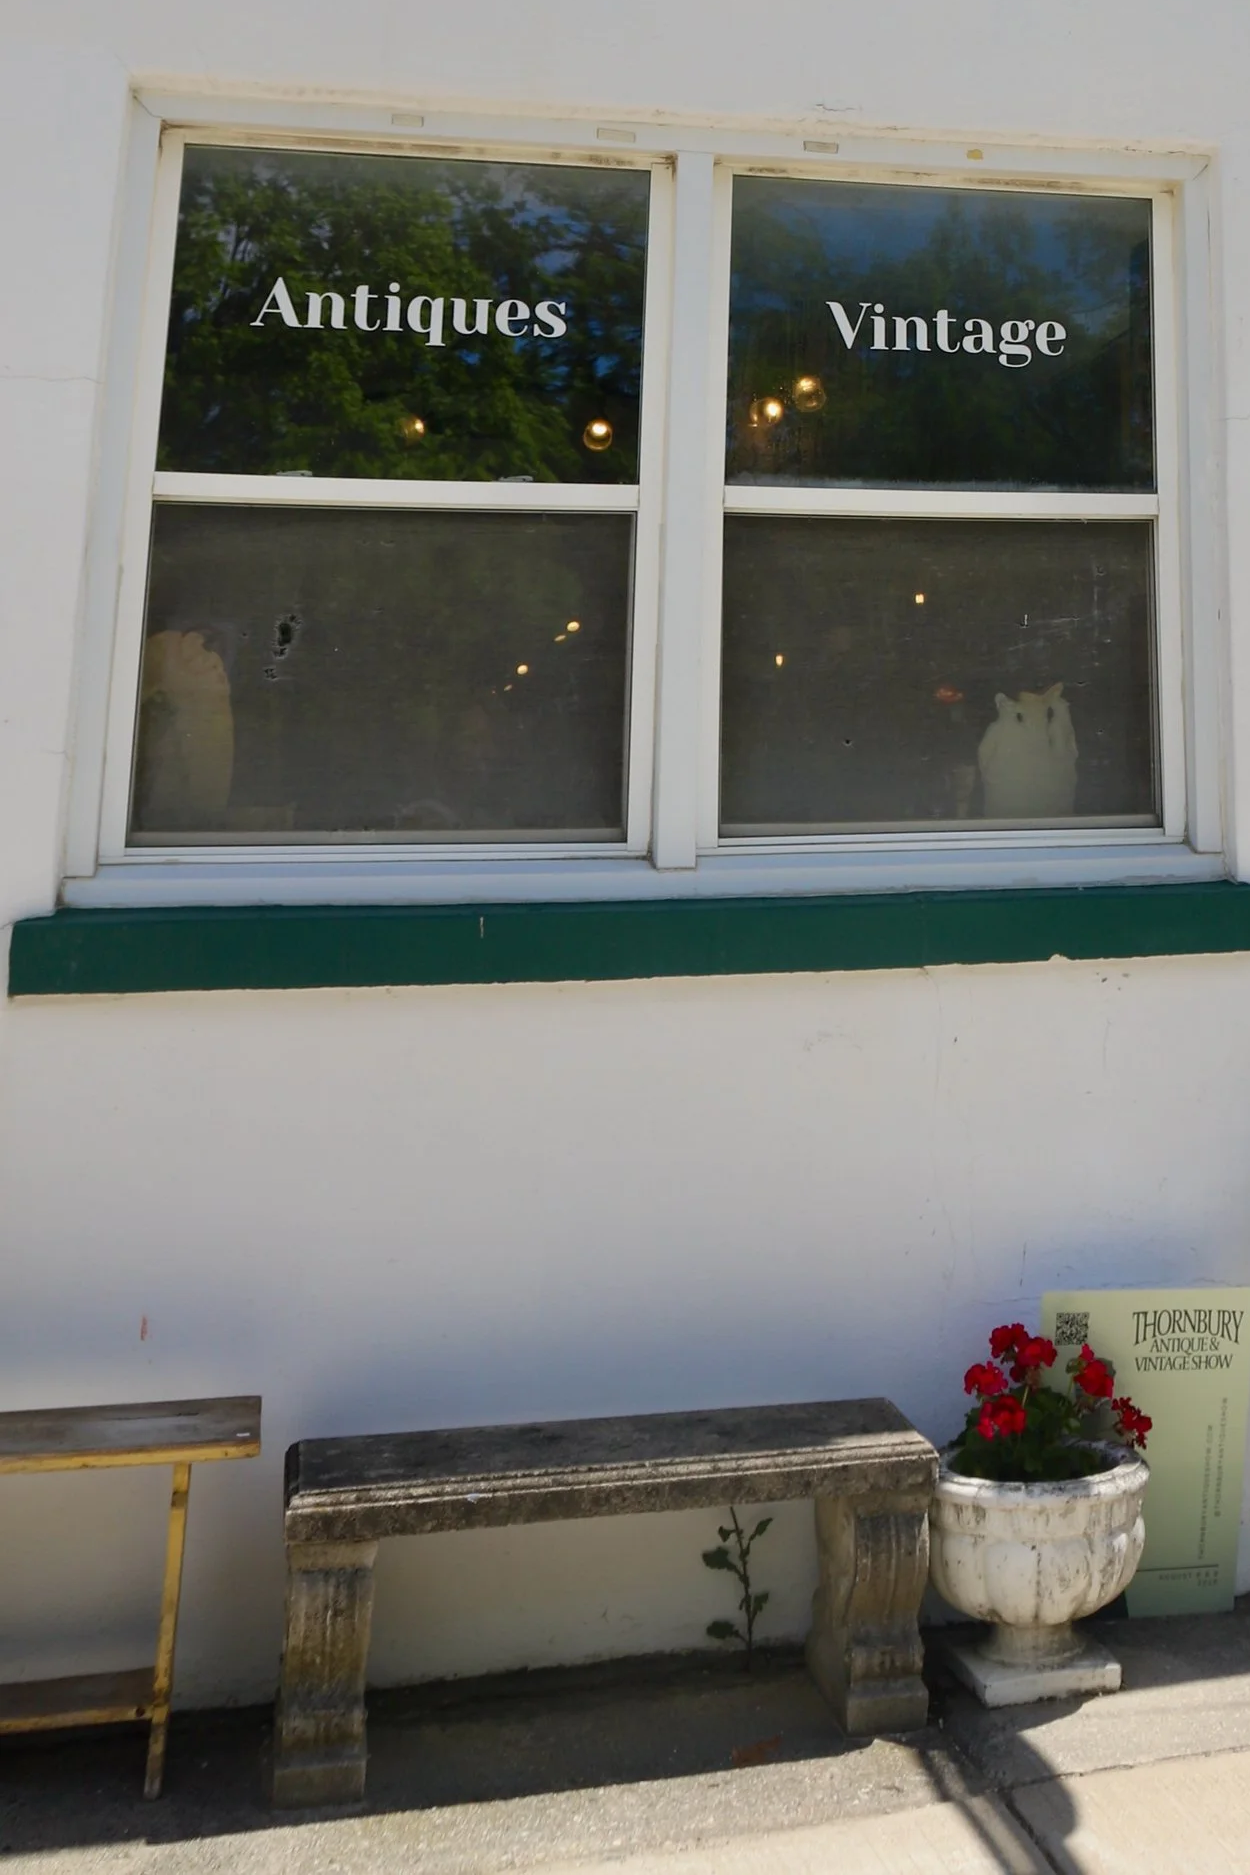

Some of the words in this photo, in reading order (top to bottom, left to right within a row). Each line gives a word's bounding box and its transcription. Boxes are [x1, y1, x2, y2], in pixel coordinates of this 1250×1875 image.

[250, 276, 568, 347] Antiques
[826, 300, 1068, 369] Vintage
[1132, 1308, 1245, 1345] THORNBURY
[1134, 1355, 1190, 1373] VINTAGE
[1191, 1354, 1235, 1370] SHOW
[1149, 1337, 1208, 1357] ANTIQUE
[1208, 1336, 1221, 1352] &
